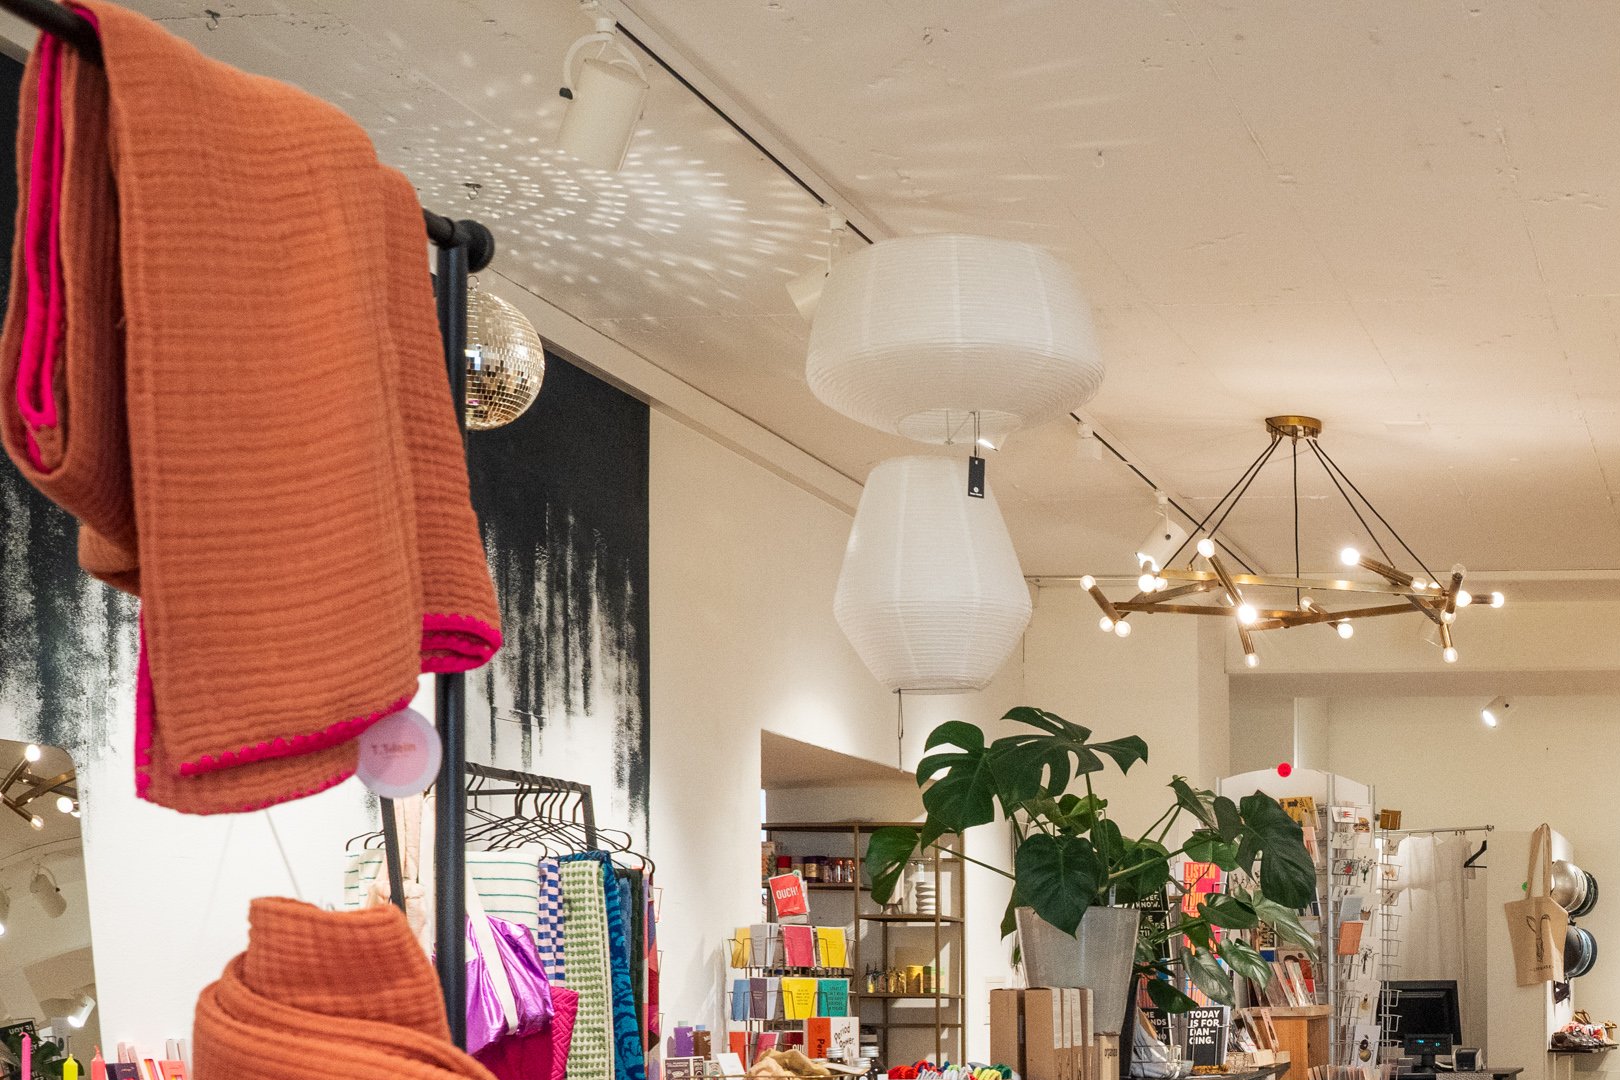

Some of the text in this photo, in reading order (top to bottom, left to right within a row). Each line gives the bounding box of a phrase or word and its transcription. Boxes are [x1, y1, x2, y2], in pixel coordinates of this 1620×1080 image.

[1185, 863, 1216, 879] LISTEN
[775, 885, 799, 900] OUCH!
[1190, 1010, 1220, 1019] TODAY
[1190, 1018, 1220, 1027] IS FOR
